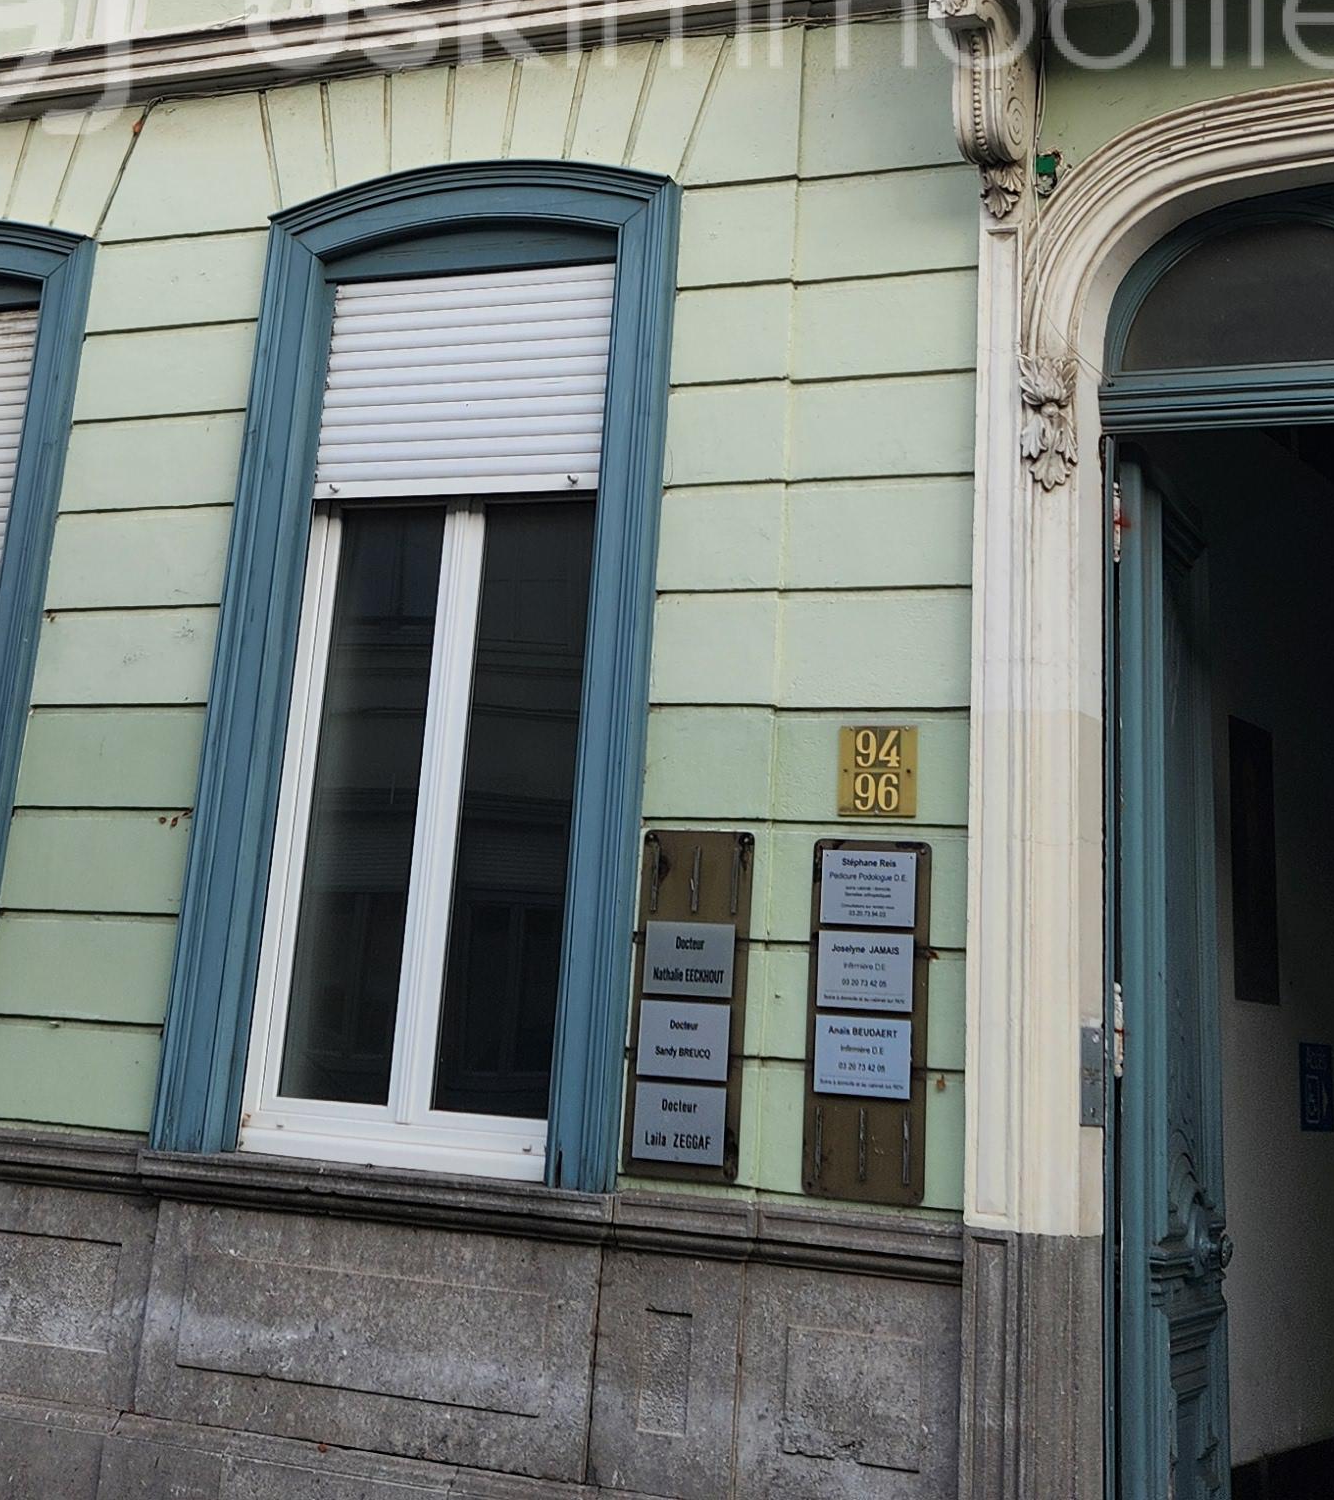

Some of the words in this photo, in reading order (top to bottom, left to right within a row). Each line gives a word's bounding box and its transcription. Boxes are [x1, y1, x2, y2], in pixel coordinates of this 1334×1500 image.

[855, 729, 901, 768] 94
[854, 773, 899, 811] 96
[841, 858, 877, 868] Stéphane
[879, 859, 897, 868] Reis
[675, 936, 705, 950] Docteur
[831, 943, 866, 954] Joselyne
[868, 945, 900, 955] JAMAIS
[653, 966, 684, 982] Nathalie
[685, 968, 725, 984] EECKHOUT
[669, 1019, 699, 1031] Docteur
[655, 1045, 677, 1059] Sandy
[678, 1047, 711, 1060] BREUCQ
[661, 1098, 698, 1114] Docteur
[645, 1130, 667, 1147] Laila
[673, 1133, 711, 1151] ZEGGAF
